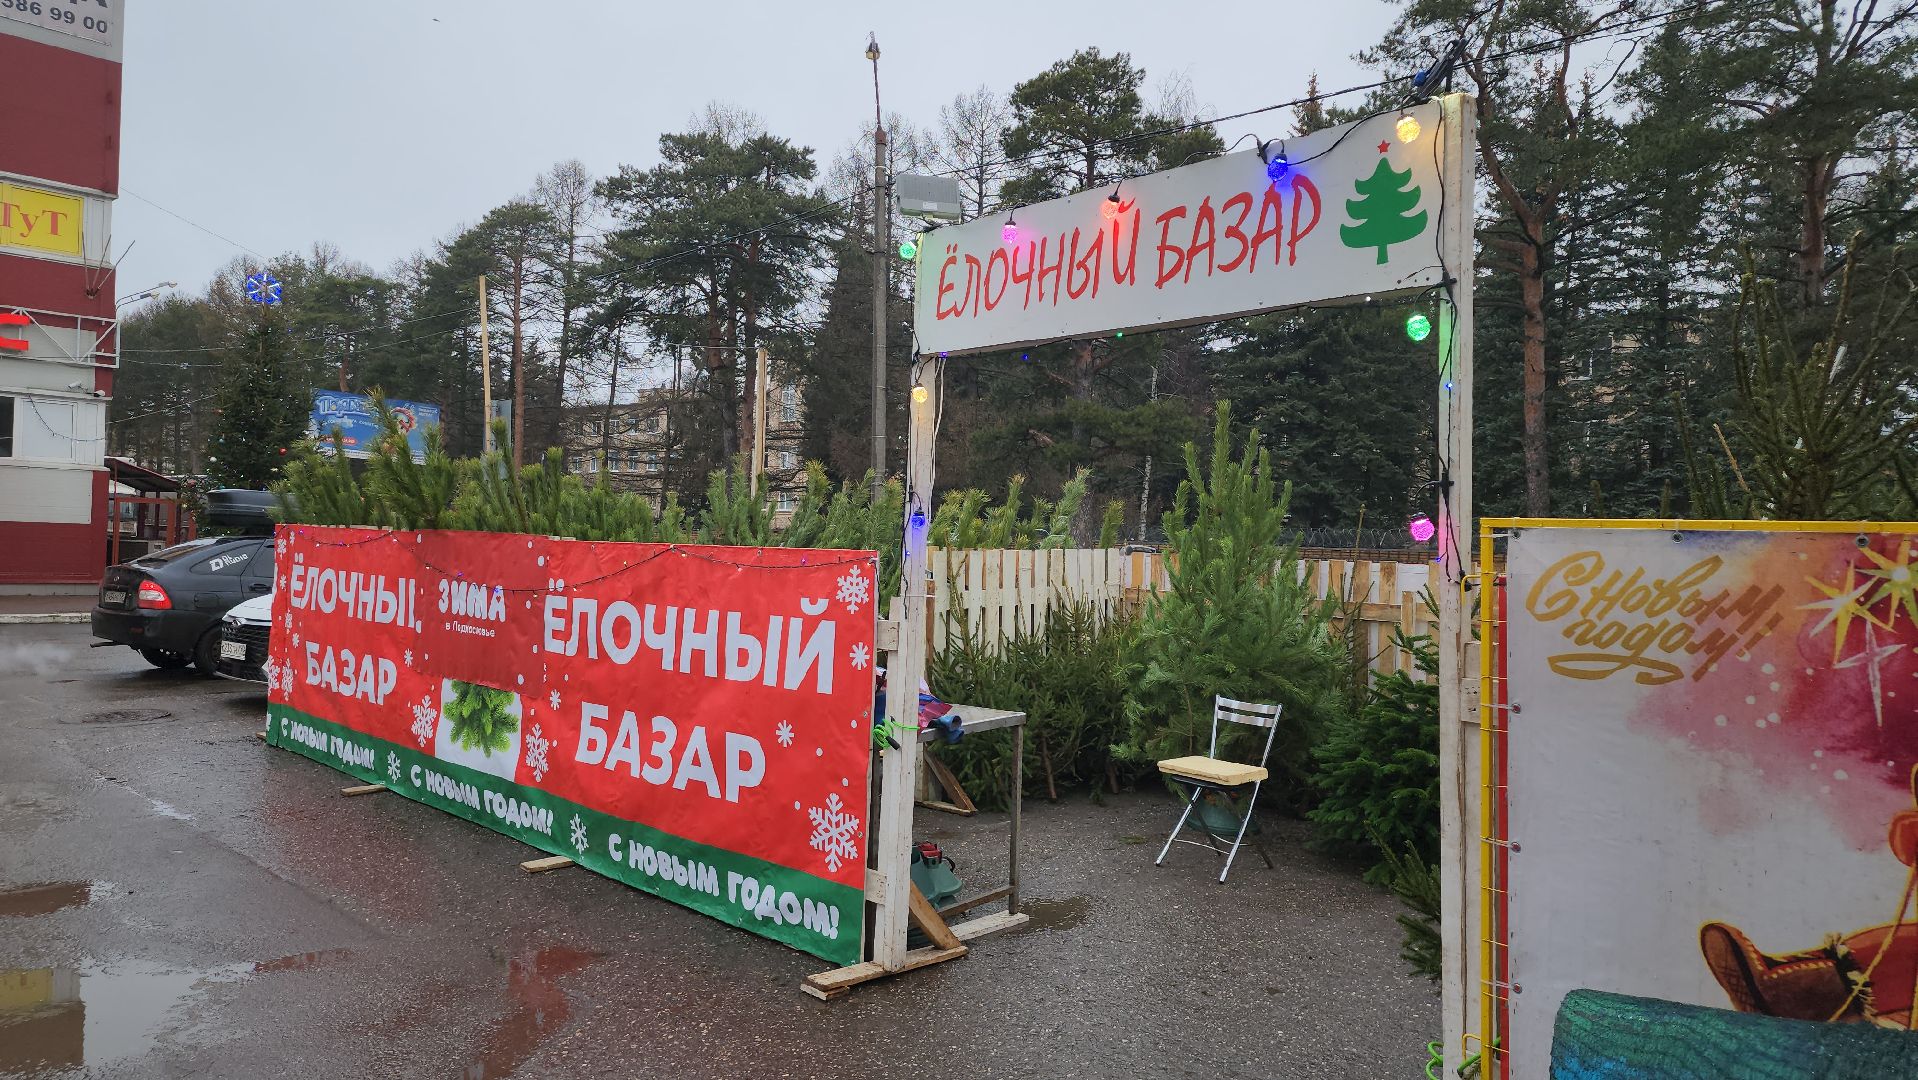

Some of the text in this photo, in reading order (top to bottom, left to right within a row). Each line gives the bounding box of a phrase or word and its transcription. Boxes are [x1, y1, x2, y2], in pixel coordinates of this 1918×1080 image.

[49, 7, 76, 24] 99
[83, 16, 108, 33] 00
[936, 174, 1321, 320] ЁЛОЧНЫЙ БАЗАР
[438, 578, 506, 623] ЗИМА
[445, 622, 451, 631] в
[1526, 551, 1785, 635] С Новым
[543, 578, 836, 695] ЁЛОЧНЫЙ
[1547, 611, 1784, 685] годом!
[305, 641, 398, 706] БАЗАР
[281, 717, 289, 737] С
[330, 735, 375, 771] ГОДОМ!
[575, 701, 766, 803] БАЗАР
[410, 764, 554, 836] С НОВЫМ ГОДОМ!
[608, 833, 840, 940] С НОВЫМ ГОДОМ!
